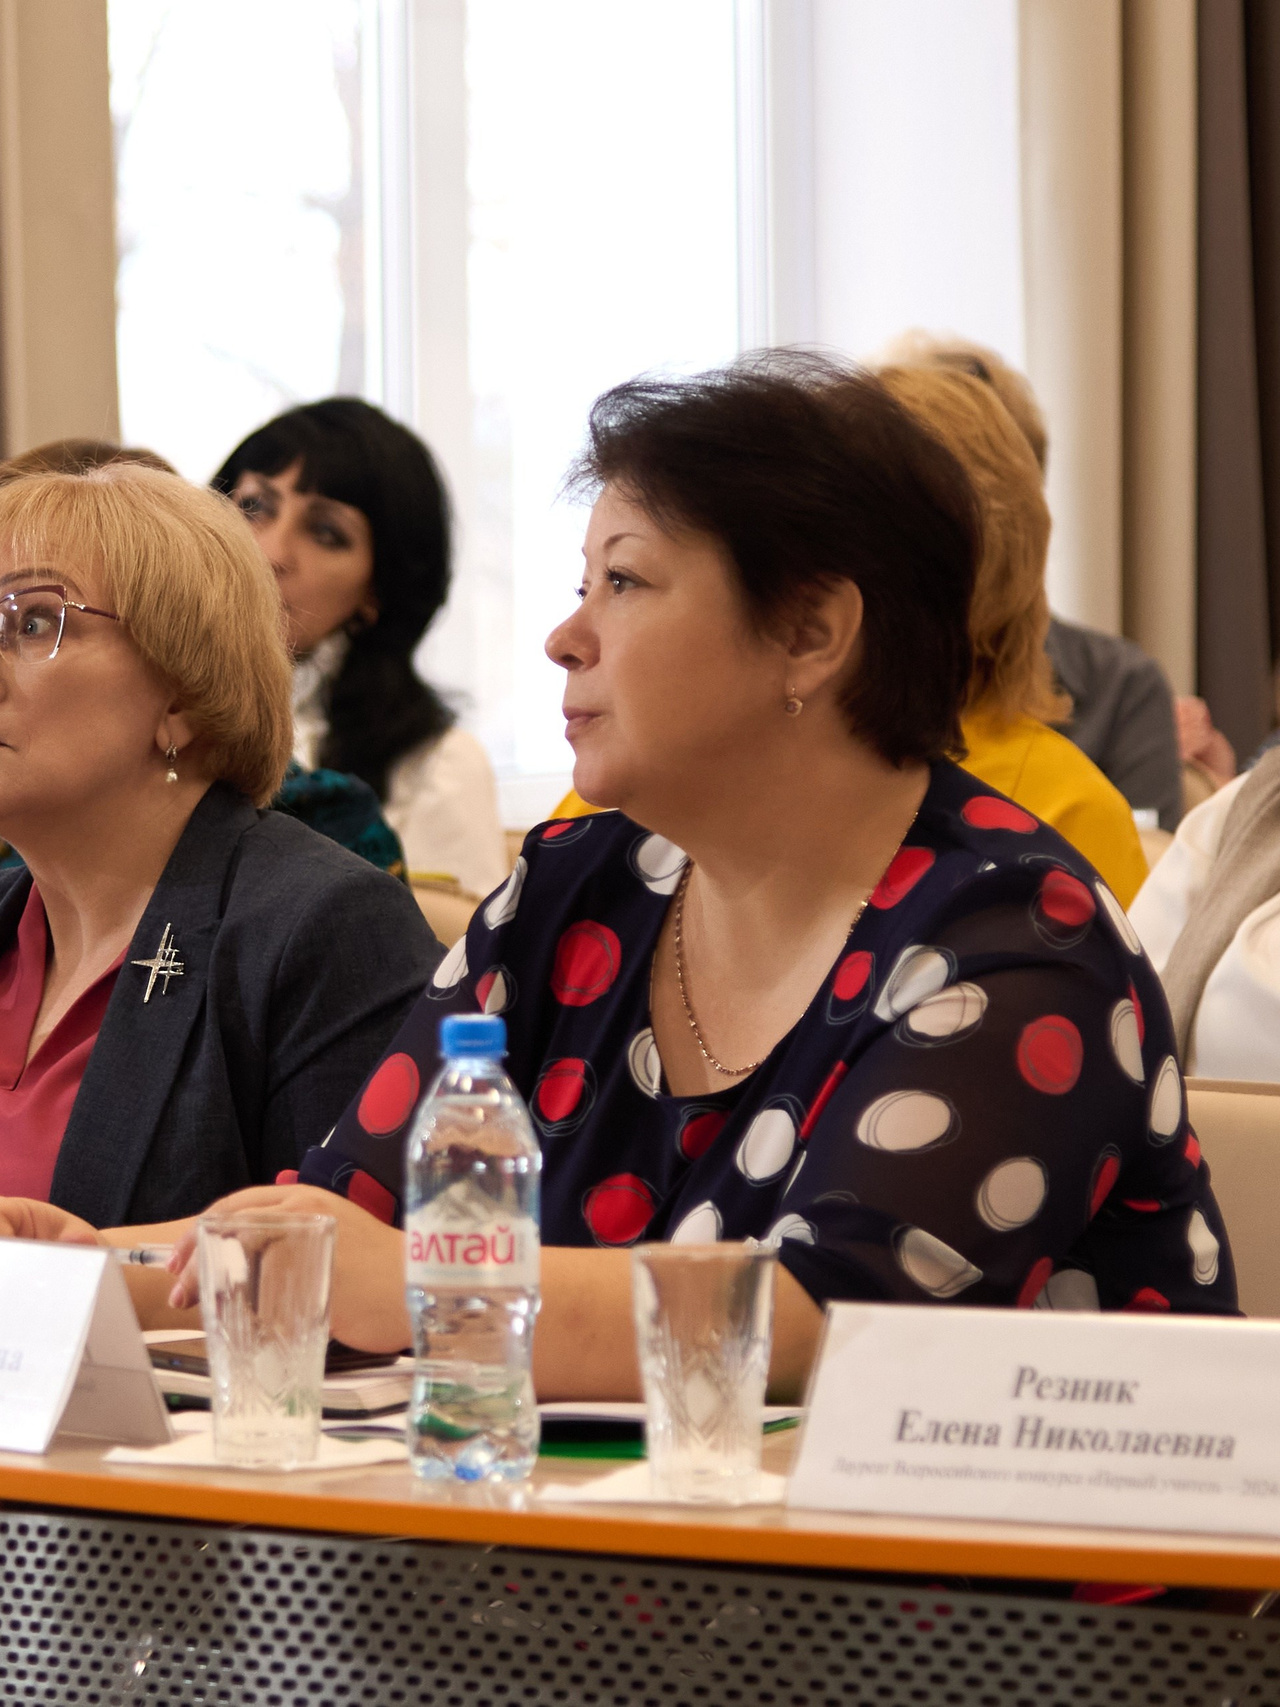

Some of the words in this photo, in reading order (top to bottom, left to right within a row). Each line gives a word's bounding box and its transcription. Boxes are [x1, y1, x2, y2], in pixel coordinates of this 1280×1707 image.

[410, 1226, 515, 1265] алтай
[1012, 1366, 1140, 1405] Резник
[895, 1408, 1001, 1447] Елена
[1013, 1414, 1236, 1460] Николаевна
